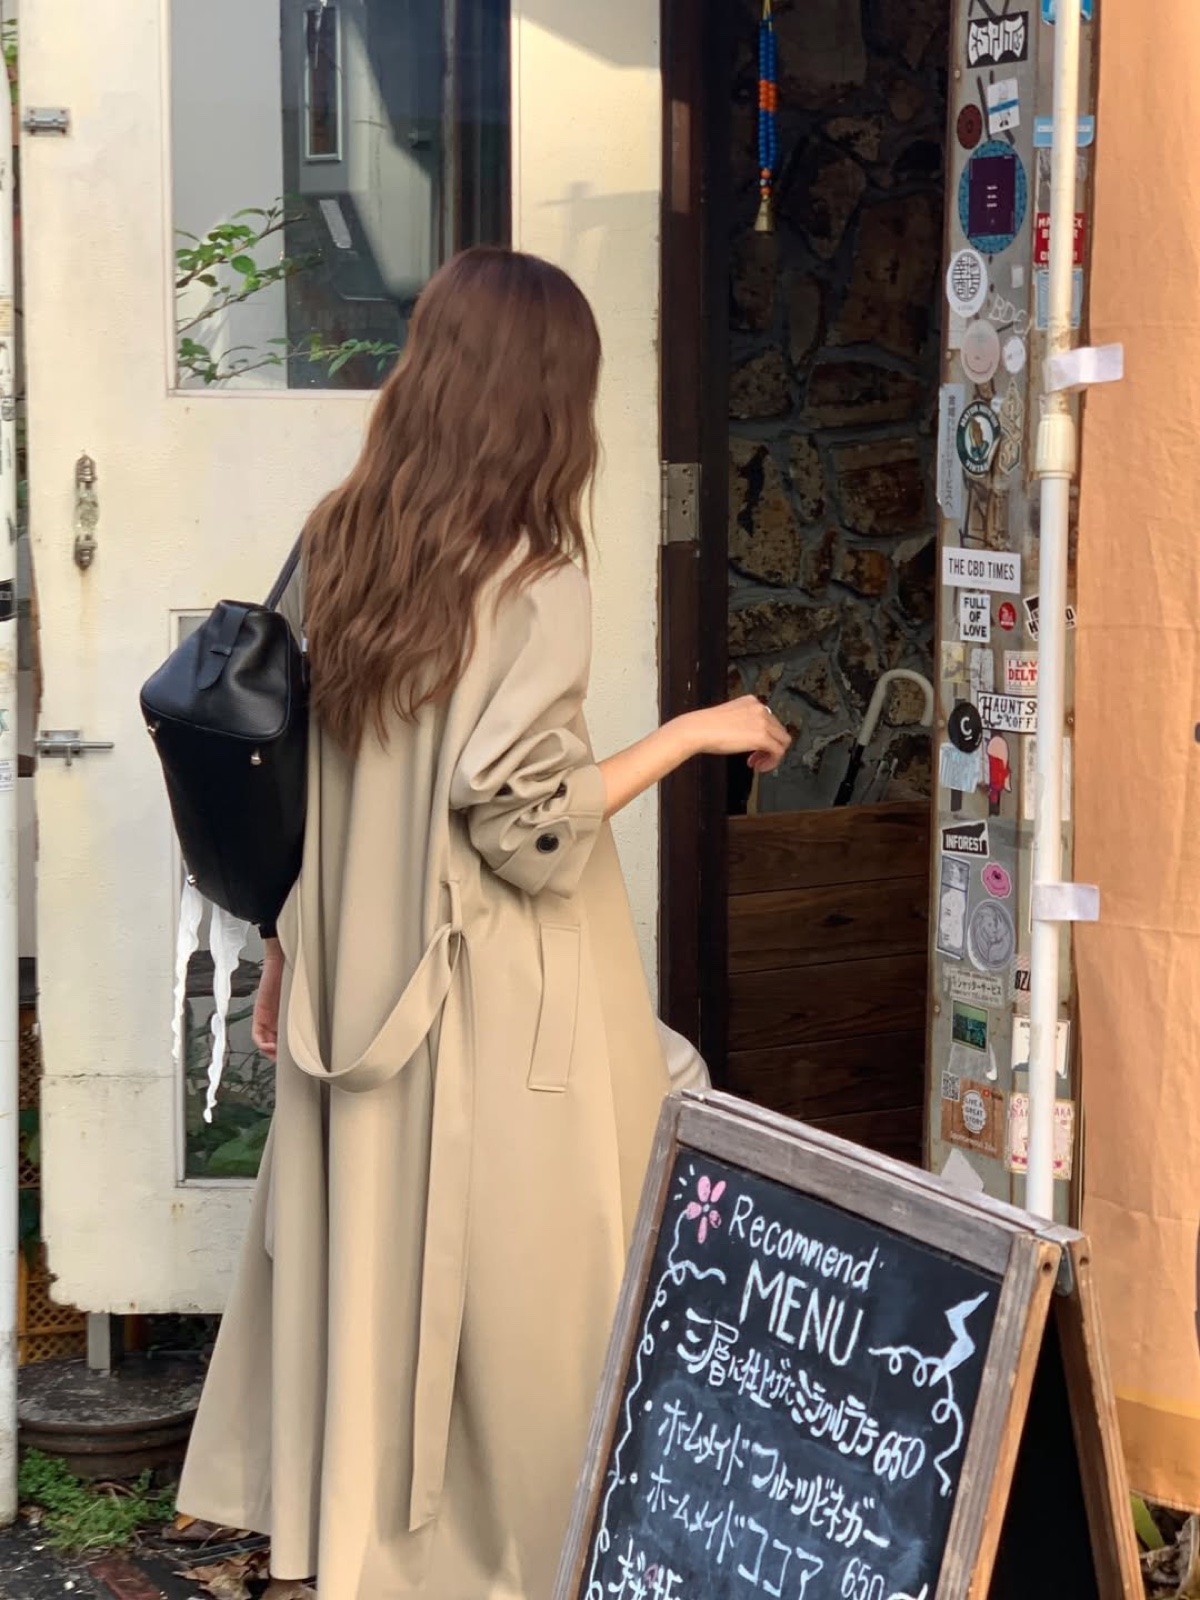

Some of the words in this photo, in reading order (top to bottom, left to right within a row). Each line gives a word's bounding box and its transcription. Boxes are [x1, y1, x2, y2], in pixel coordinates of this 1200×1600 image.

[948, 558, 965, 575] THE
[967, 560, 985, 577] CBD
[988, 561, 1014, 580] TIMES
[964, 596, 987, 609] FULL
[969, 611, 981, 622] OF
[963, 624, 987, 637] LOVE
[1008, 669, 1038, 681] DELT
[945, 834, 984, 852] INFOREST
[729, 1194, 879, 1292] Recommend
[739, 1258, 864, 1366] MENU
[873, 1431, 926, 1481] 650
[841, 1557, 885, 1600] 650
